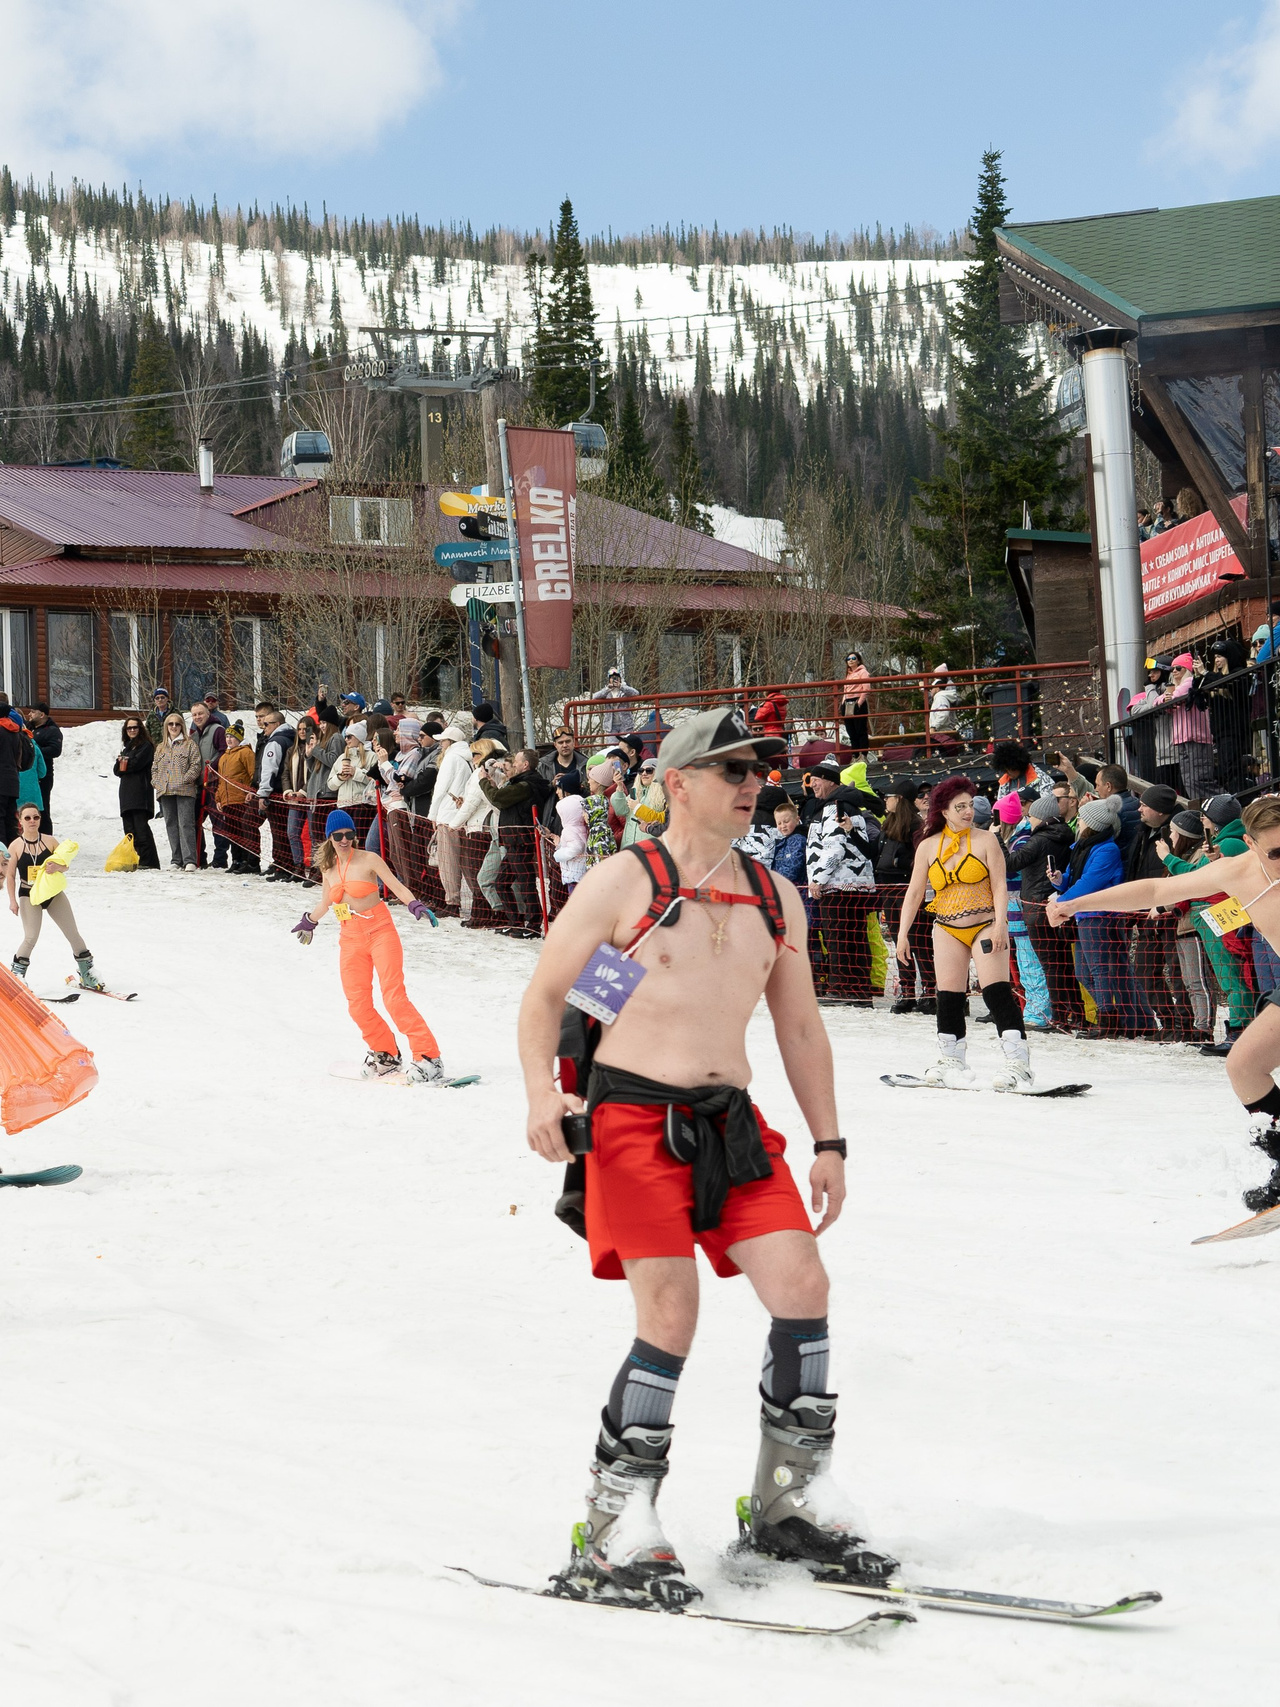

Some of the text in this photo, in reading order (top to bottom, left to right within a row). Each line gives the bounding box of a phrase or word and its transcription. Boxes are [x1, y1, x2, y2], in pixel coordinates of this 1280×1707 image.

[428, 412, 442, 423] 13
[529, 486, 572, 601] GRELKA
[441, 548, 488, 560] Mammoth
[1155, 551, 1175, 569] CREAM
[1167, 561, 1192, 583] КОНКУРС
[594, 985, 609, 998] 14
